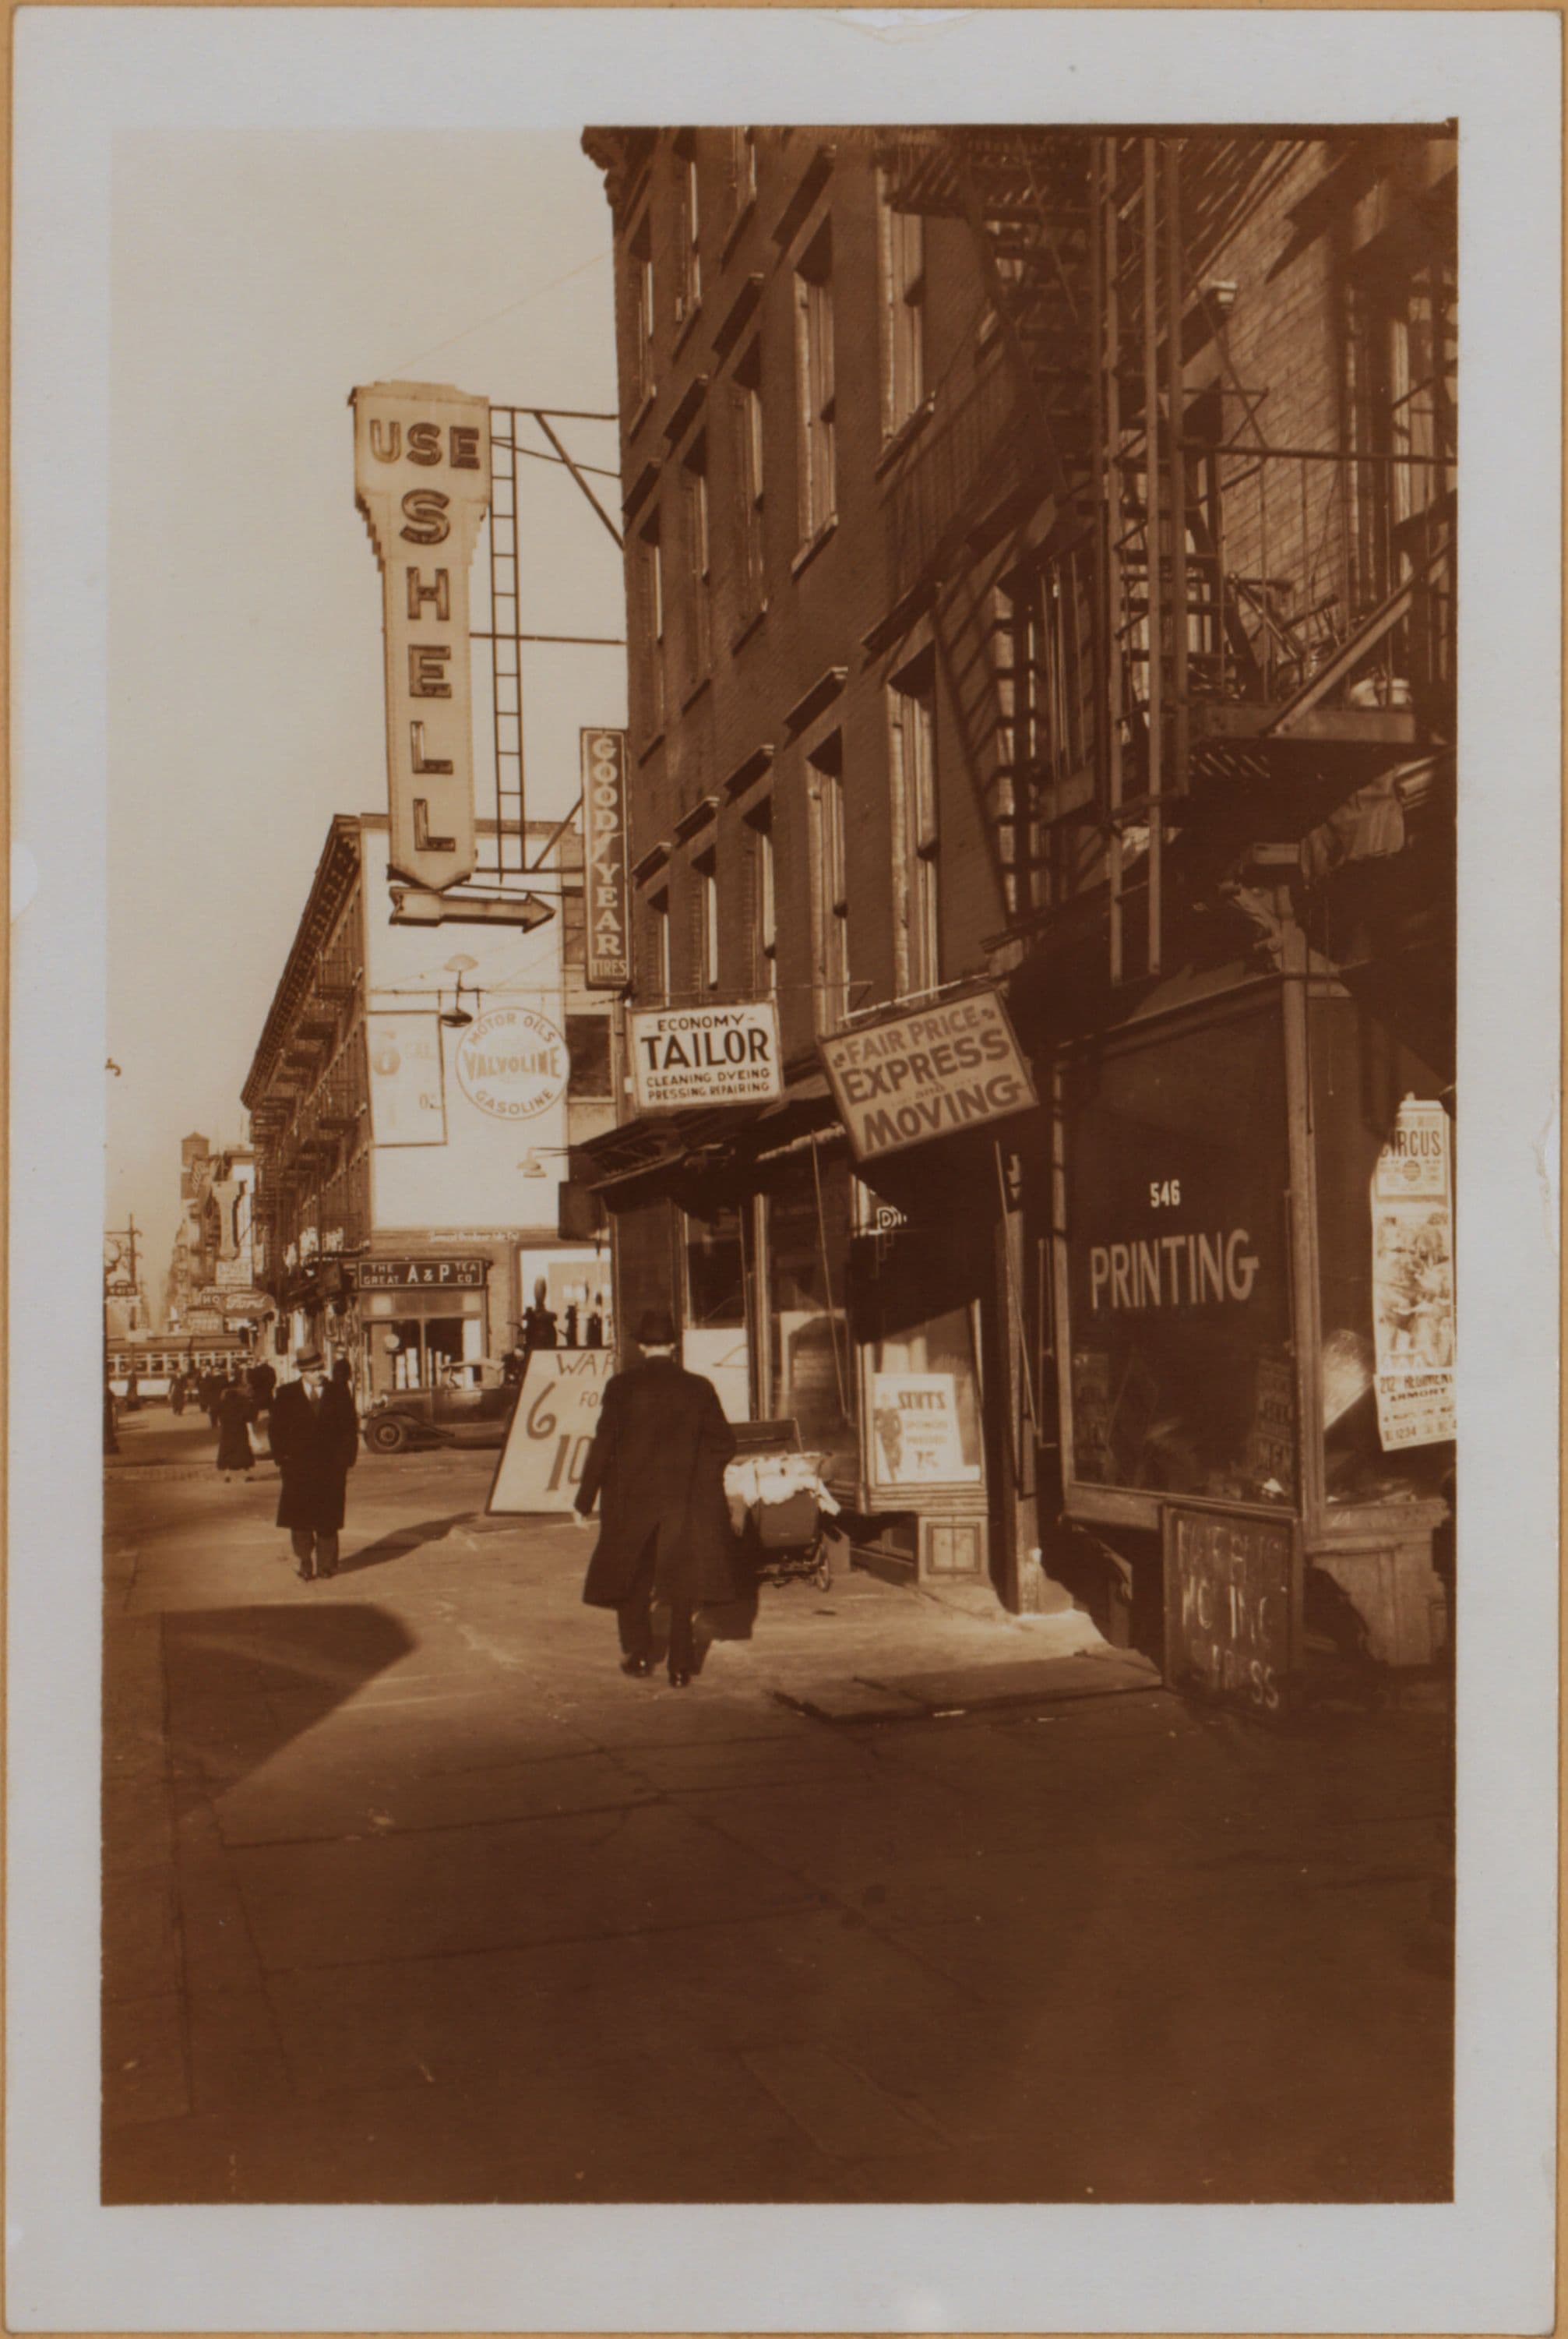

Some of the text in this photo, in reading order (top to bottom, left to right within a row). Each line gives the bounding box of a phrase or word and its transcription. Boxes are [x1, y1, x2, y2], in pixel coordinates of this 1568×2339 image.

[368, 418, 481, 470] USE
[398, 488, 456, 852] SHELL
[590, 959, 628, 976] TIRES
[468, 1012, 555, 1046] MOTOR OILS
[657, 1013, 745, 1032] ECONOMY
[846, 1004, 980, 1065] FAIR PRICE
[463, 1046, 562, 1081] VALVOLINE
[640, 1028, 770, 1071] TAILOR
[647, 1067, 770, 1088] CLEANING DYEING
[840, 1028, 1010, 1106] EXPRESS
[475, 1088, 554, 1115] GASOLINE
[648, 1081, 770, 1101] PRESSING REPAIRING
[862, 1074, 1024, 1152] MOVING
[1149, 1179, 1181, 1208] 546
[363, 1275, 400, 1285] GREAT
[371, 1264, 393, 1273] THE
[455, 1261, 477, 1272] TEA
[1091, 1228, 1260, 1310] PRINTING
[225, 1293, 264, 1310] Ford
[527, 1381, 556, 1441] 6
